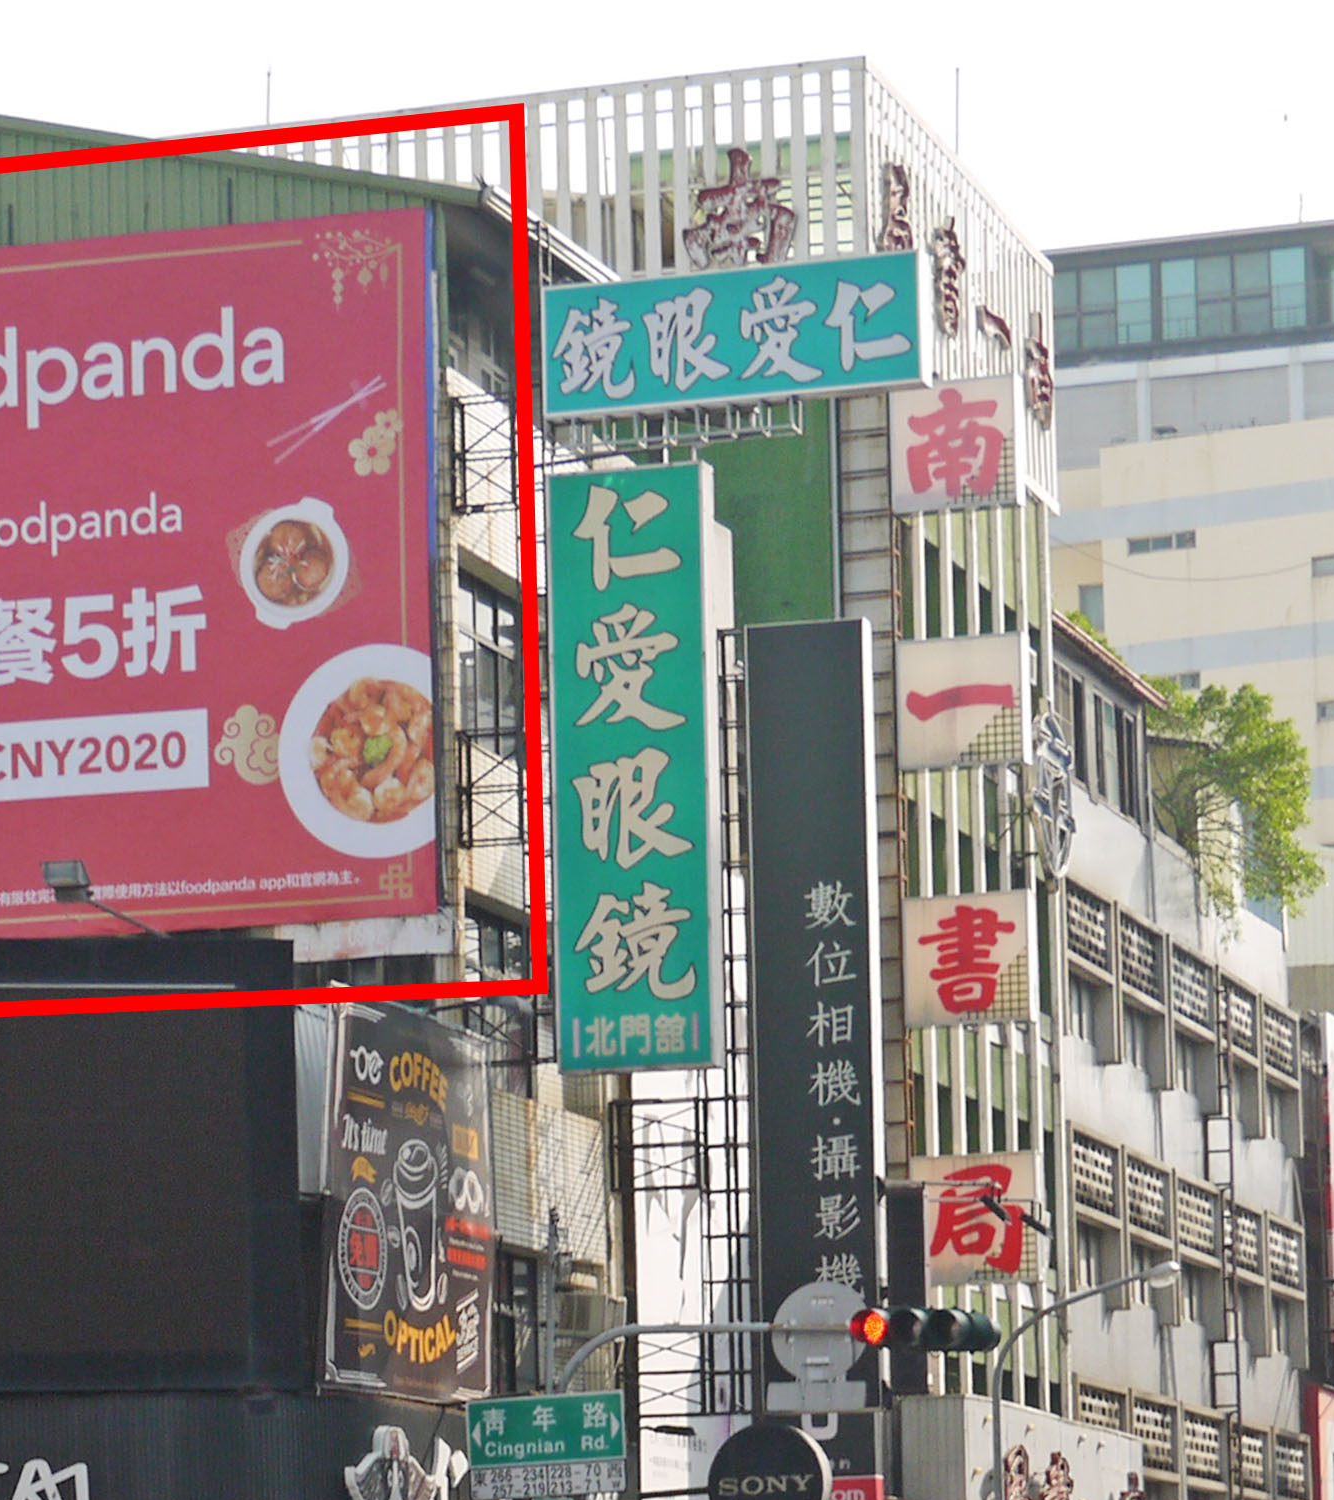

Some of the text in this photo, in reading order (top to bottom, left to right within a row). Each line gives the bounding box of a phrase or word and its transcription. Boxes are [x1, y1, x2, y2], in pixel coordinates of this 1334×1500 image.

[571, 484, 697, 1001] 仁愛眼鏡
[388, 1051, 449, 1114] COFFEE
[384, 1309, 458, 1365] OPTICAL
[482, 1402, 609, 1437] 青年路
[485, 1434, 610, 1460] Cingnian Rd.
[718, 1473, 814, 1496] SONY
